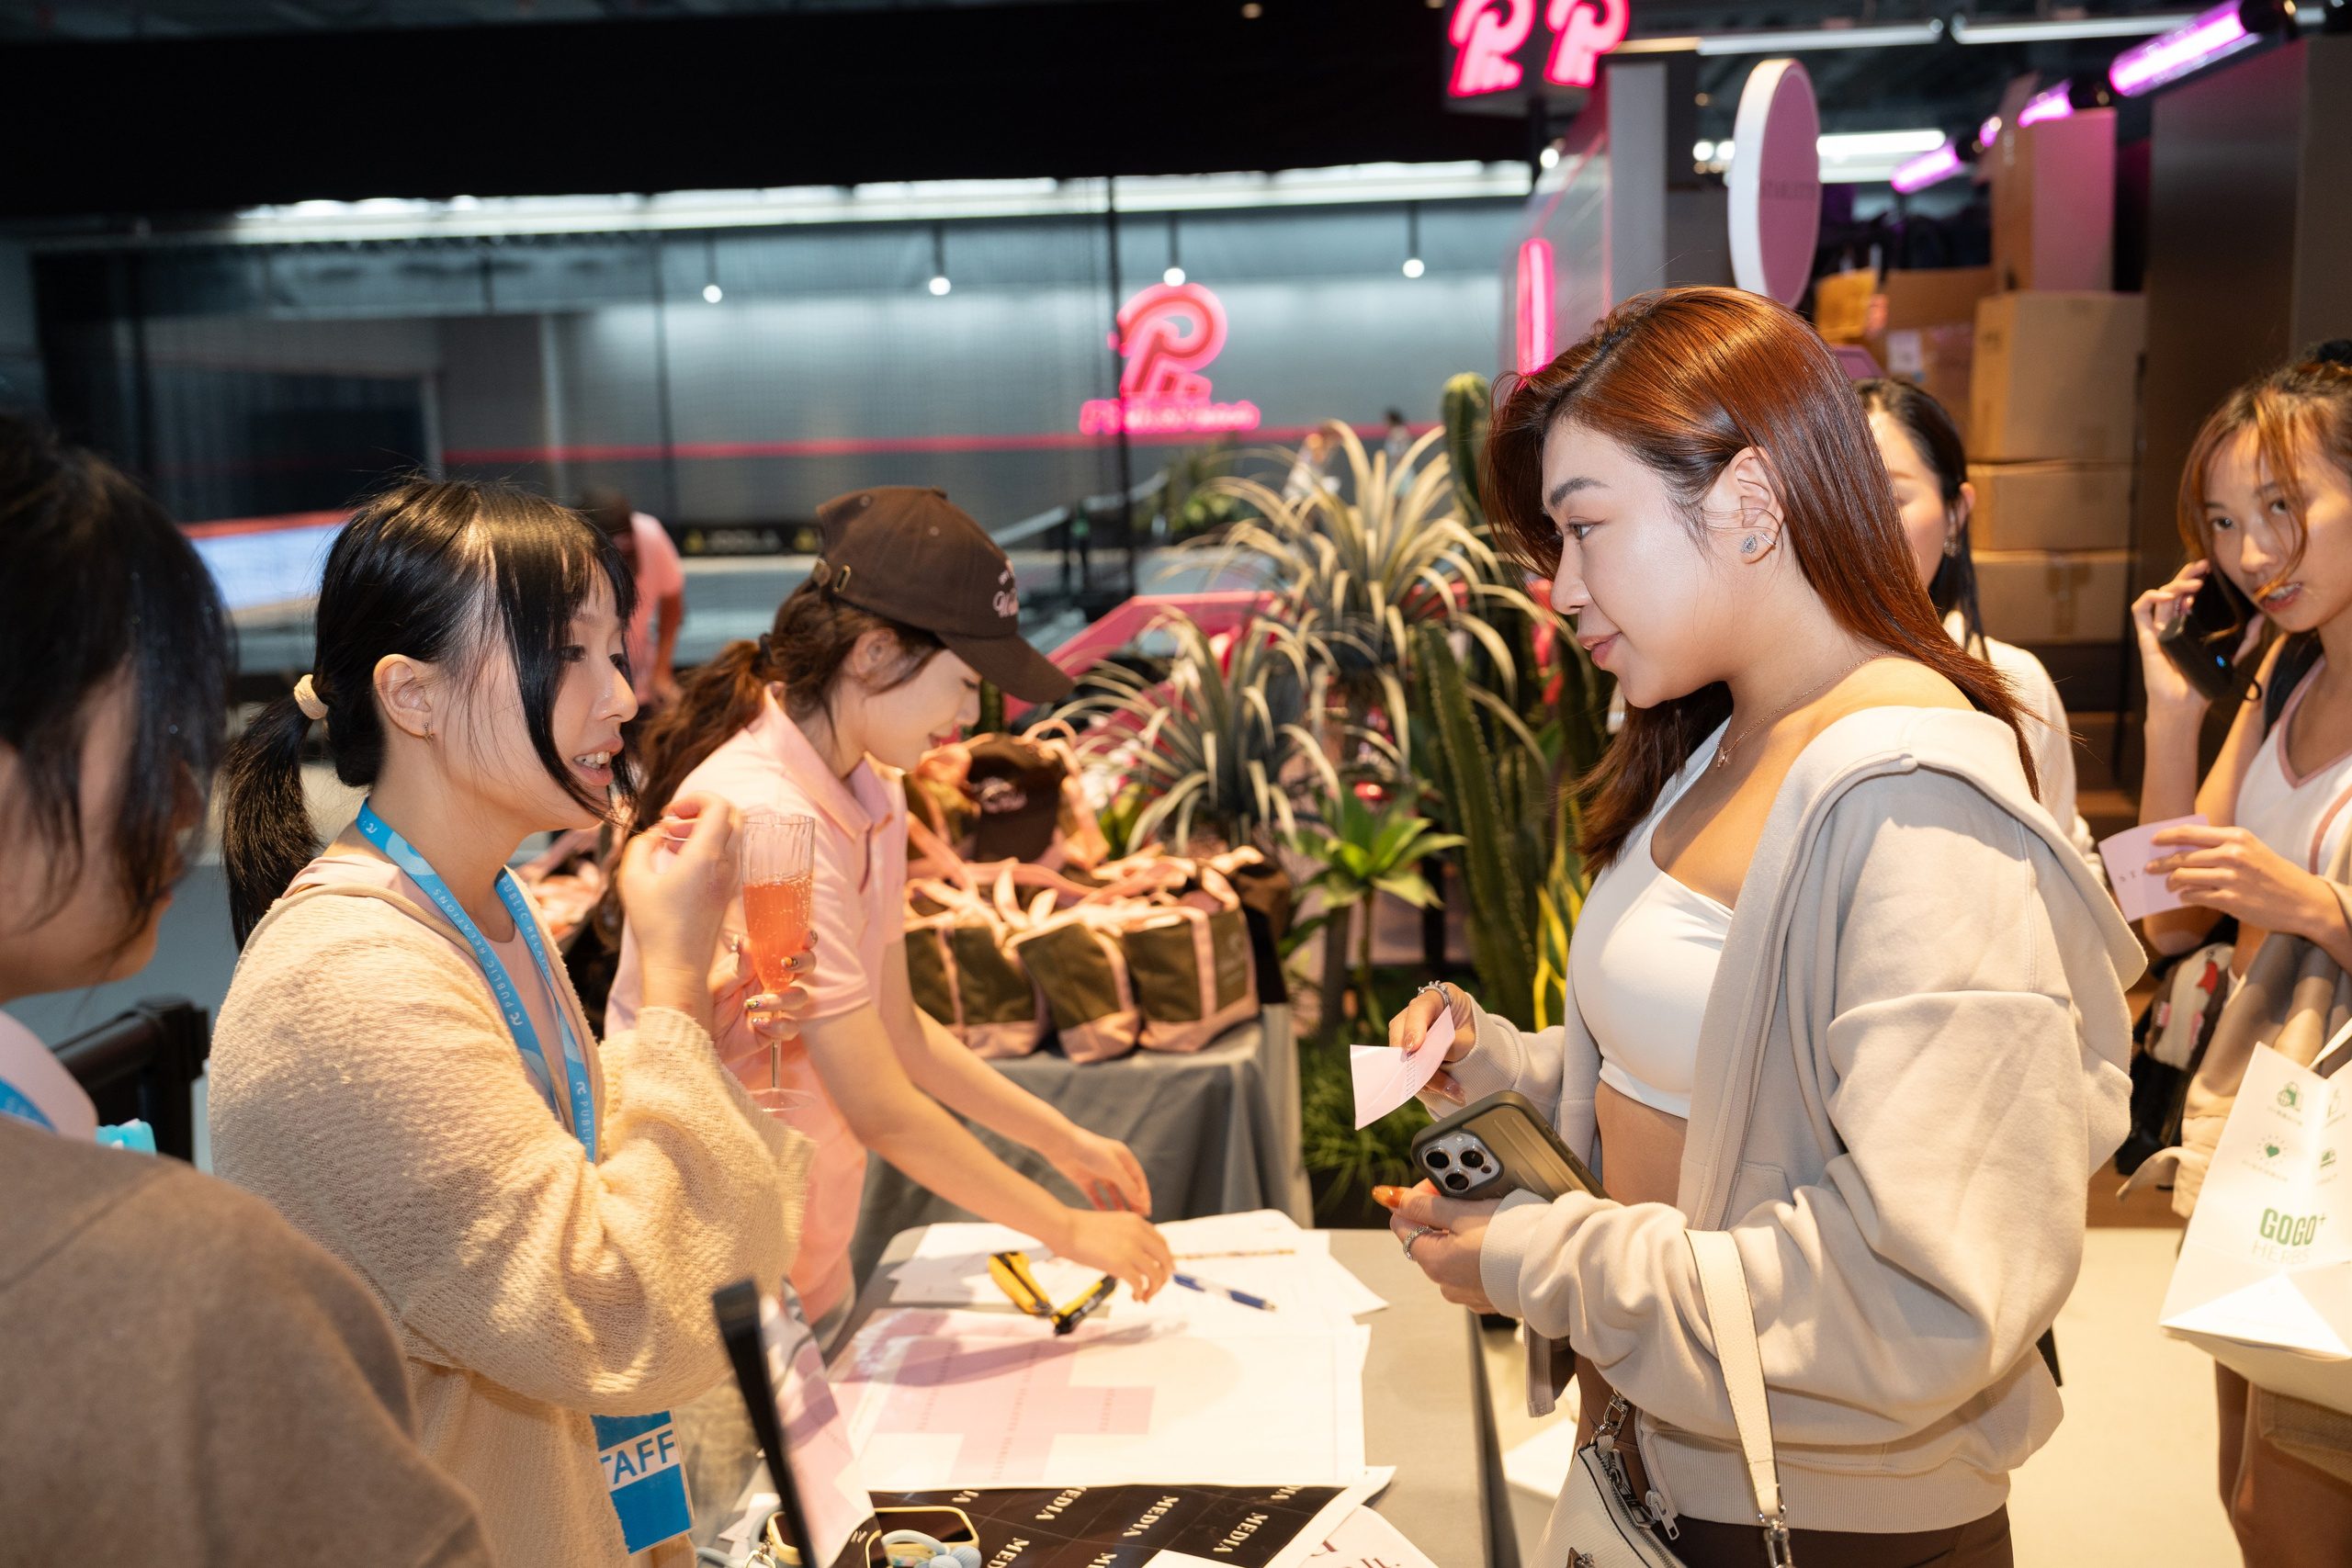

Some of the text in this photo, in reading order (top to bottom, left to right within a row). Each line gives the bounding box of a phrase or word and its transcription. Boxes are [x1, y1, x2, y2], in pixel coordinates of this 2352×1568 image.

[502, 876, 529, 919] PUBLIC
[434, 888, 487, 954] RELATIONS
[486, 960, 514, 1009] PUBLIC
[580, 1100, 593, 1150] PUBLIC
[2251, 1238, 2312, 1265] HERBS
[600, 1429, 675, 1484] AFF
[1122, 1495, 1180, 1538] MEDIA
[1213, 1512, 1269, 1552] MEDIA
[987, 1537, 1031, 1568] MED
